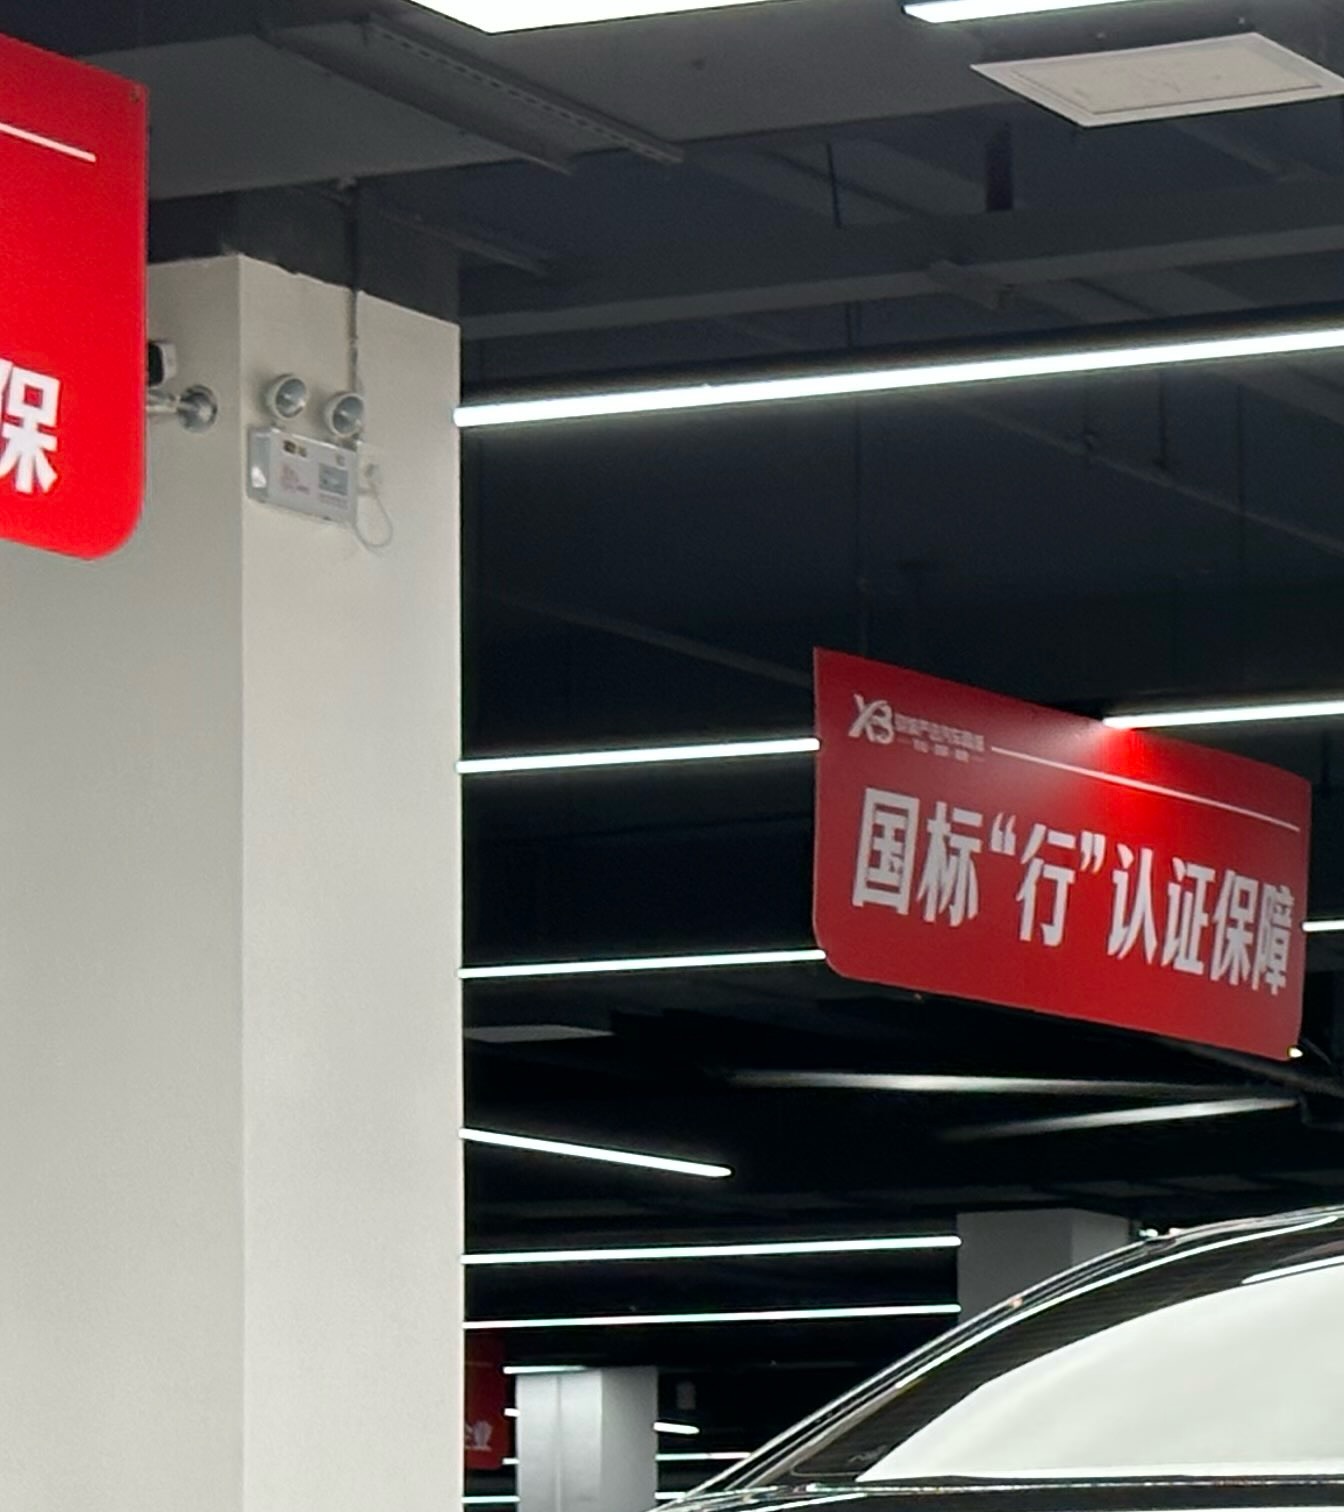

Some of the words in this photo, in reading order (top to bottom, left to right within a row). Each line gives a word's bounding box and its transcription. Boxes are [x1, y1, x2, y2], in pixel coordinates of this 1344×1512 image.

[851, 787, 1295, 995] 国标“行”认证保障
